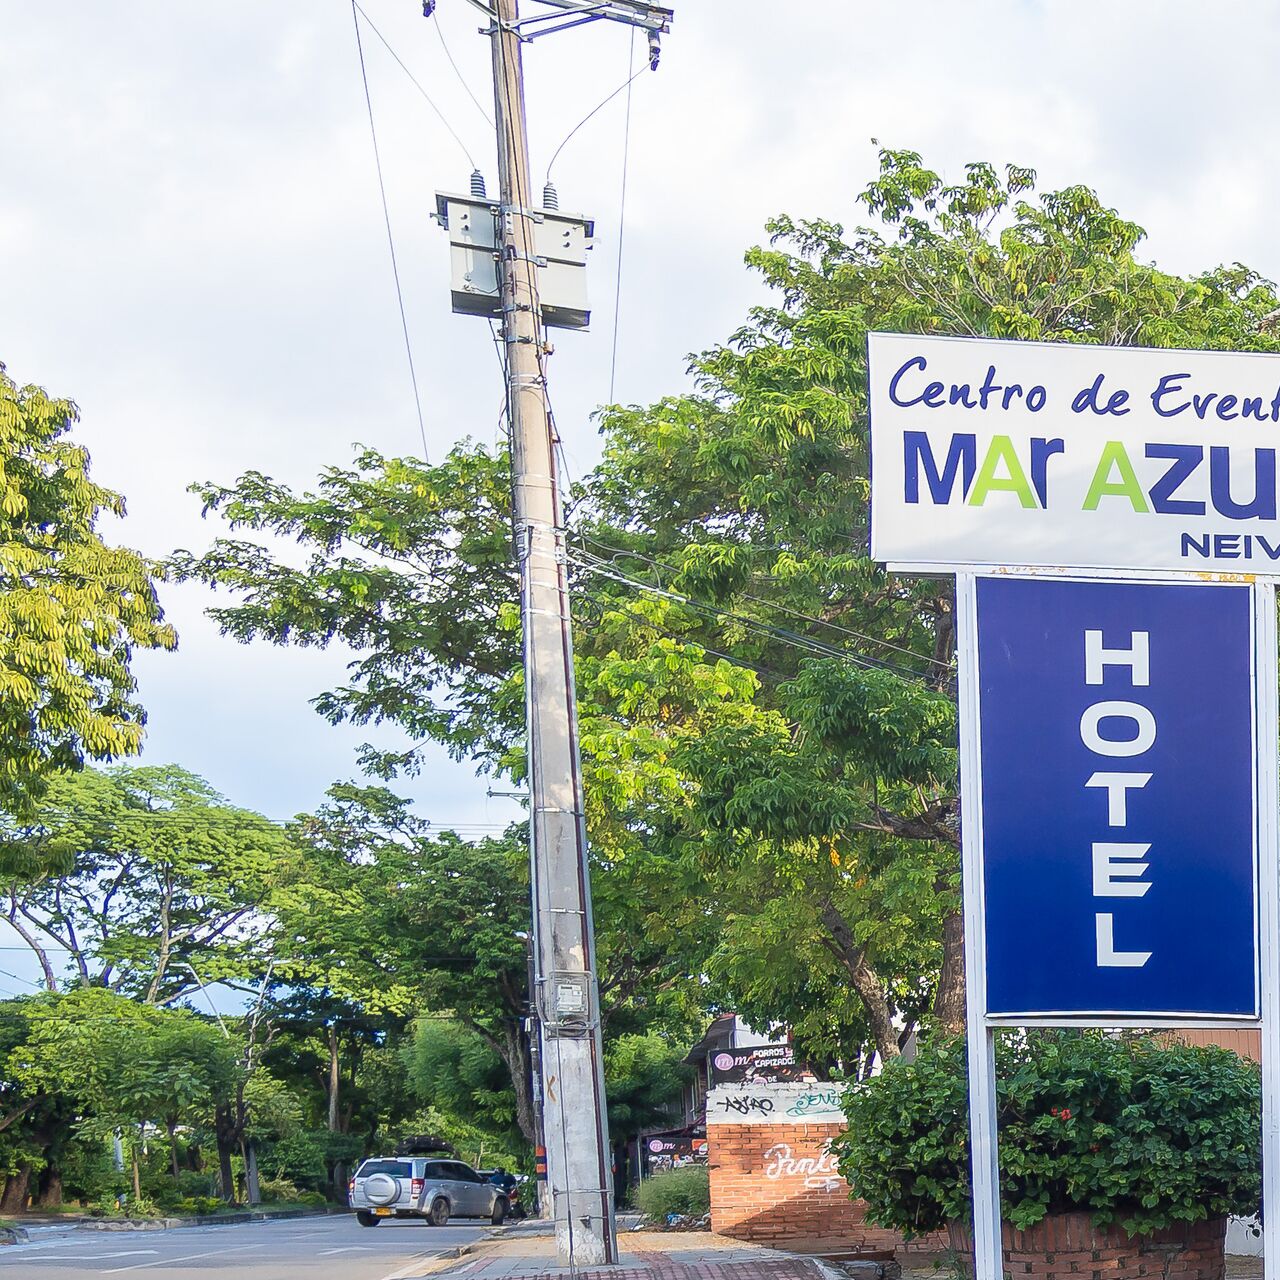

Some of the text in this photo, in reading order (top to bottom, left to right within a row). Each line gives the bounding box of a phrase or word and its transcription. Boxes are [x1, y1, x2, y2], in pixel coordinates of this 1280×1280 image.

[888, 356, 1047, 413] Centro
[1070, 373, 1131, 417] de
[1079, 629, 1157, 967] HOTEL
